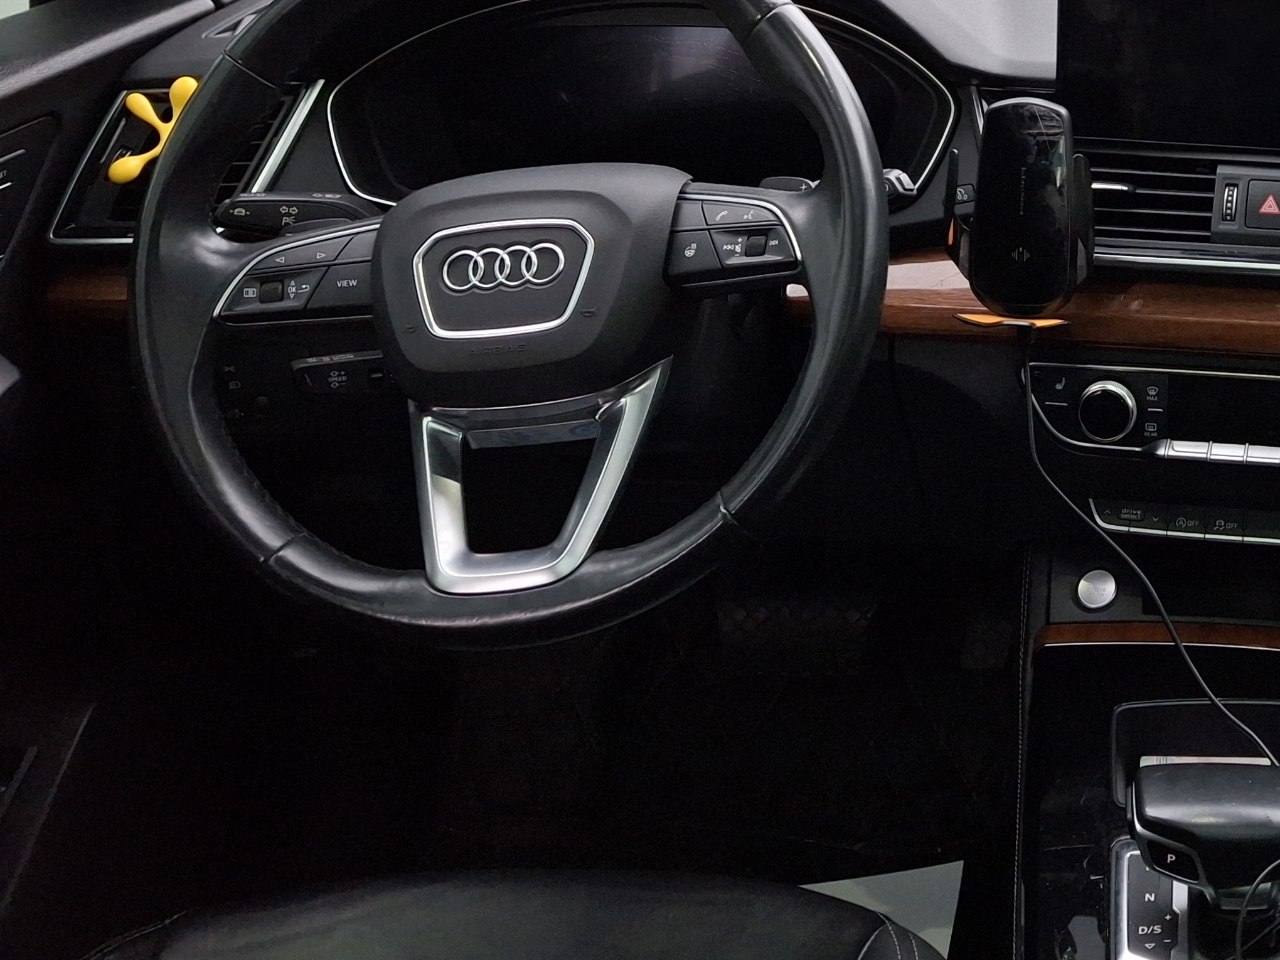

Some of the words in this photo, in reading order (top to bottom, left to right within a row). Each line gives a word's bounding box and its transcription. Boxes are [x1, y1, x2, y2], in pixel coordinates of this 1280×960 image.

[336, 279, 358, 288] VIEW
[1166, 854, 1176, 864] P
[1144, 892, 1155, 902] N
[1138, 925, 1162, 935] D/S
